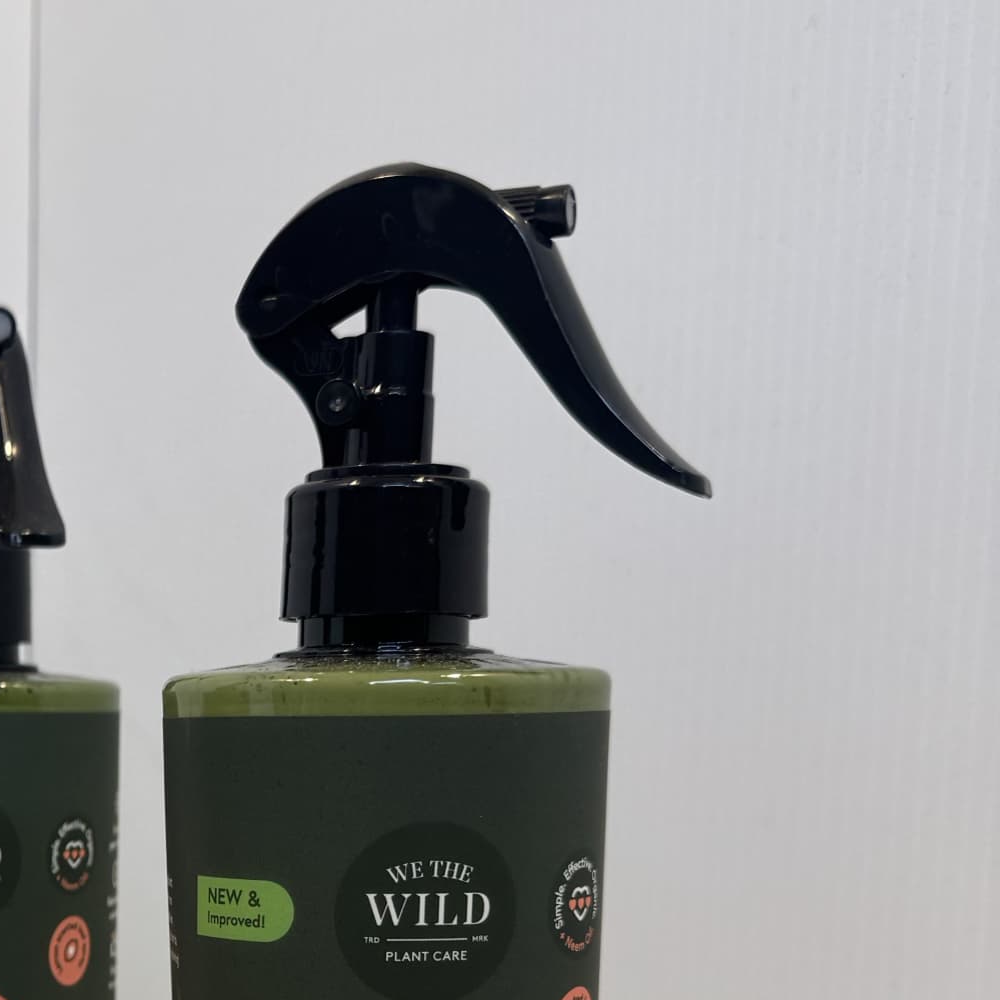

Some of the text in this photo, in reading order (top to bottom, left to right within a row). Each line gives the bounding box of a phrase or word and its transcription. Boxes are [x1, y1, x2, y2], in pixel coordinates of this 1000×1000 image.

[386, 860, 474, 883] WE THE
[208, 887, 262, 908] NEW &
[207, 909, 265, 929] Improved!
[365, 892, 490, 926] WILD
[385, 950, 468, 962] PLANT CARE
